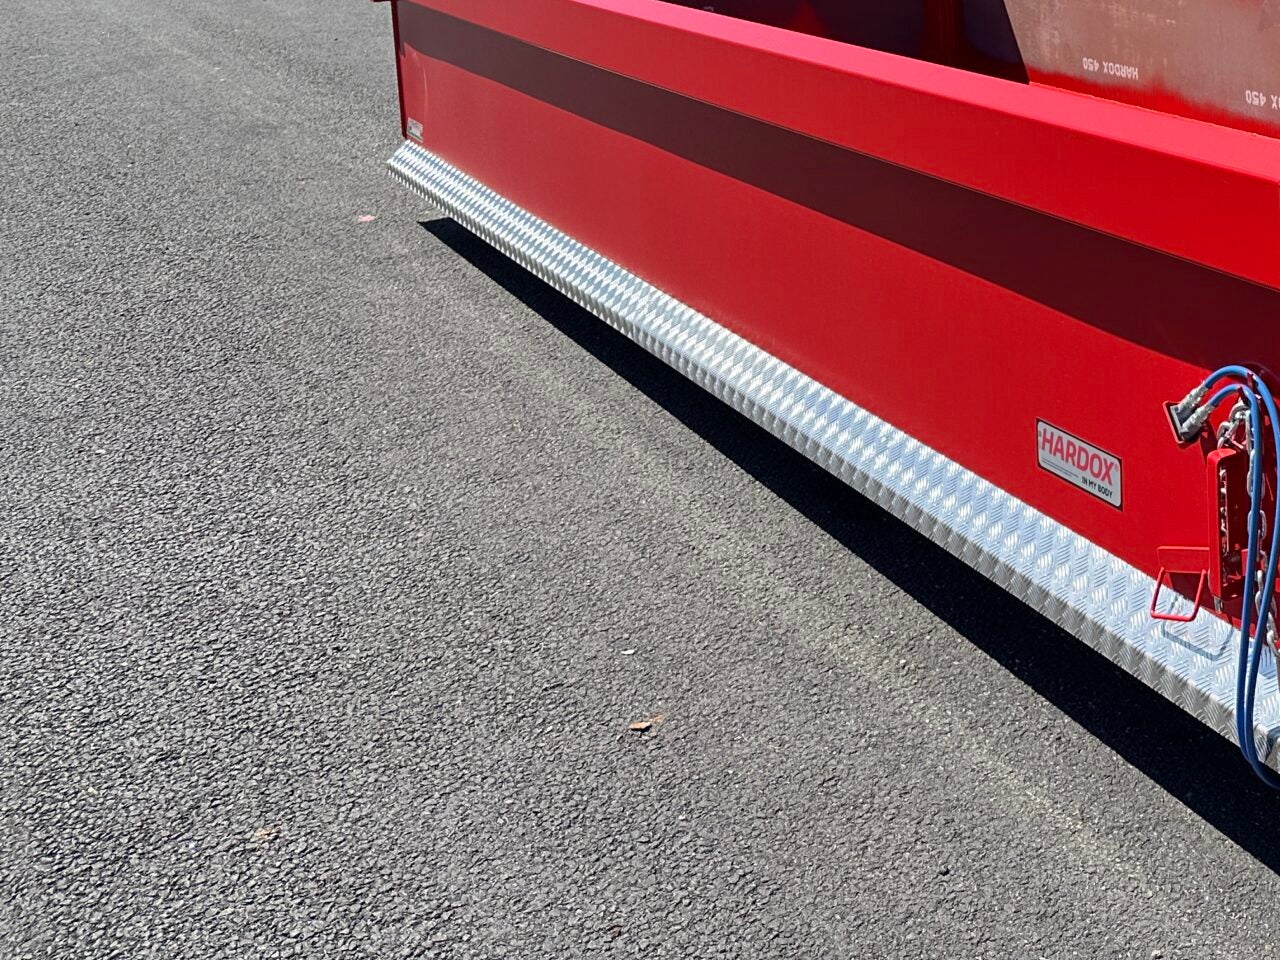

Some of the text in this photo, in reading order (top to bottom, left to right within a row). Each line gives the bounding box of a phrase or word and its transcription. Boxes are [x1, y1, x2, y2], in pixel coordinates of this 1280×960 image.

[1082, 57, 1138, 80] HARDOX 450
[1245, 90, 1267, 107] 450
[1042, 428, 1114, 486] HARDOX
[1081, 475, 1113, 499] IN MY BODY
